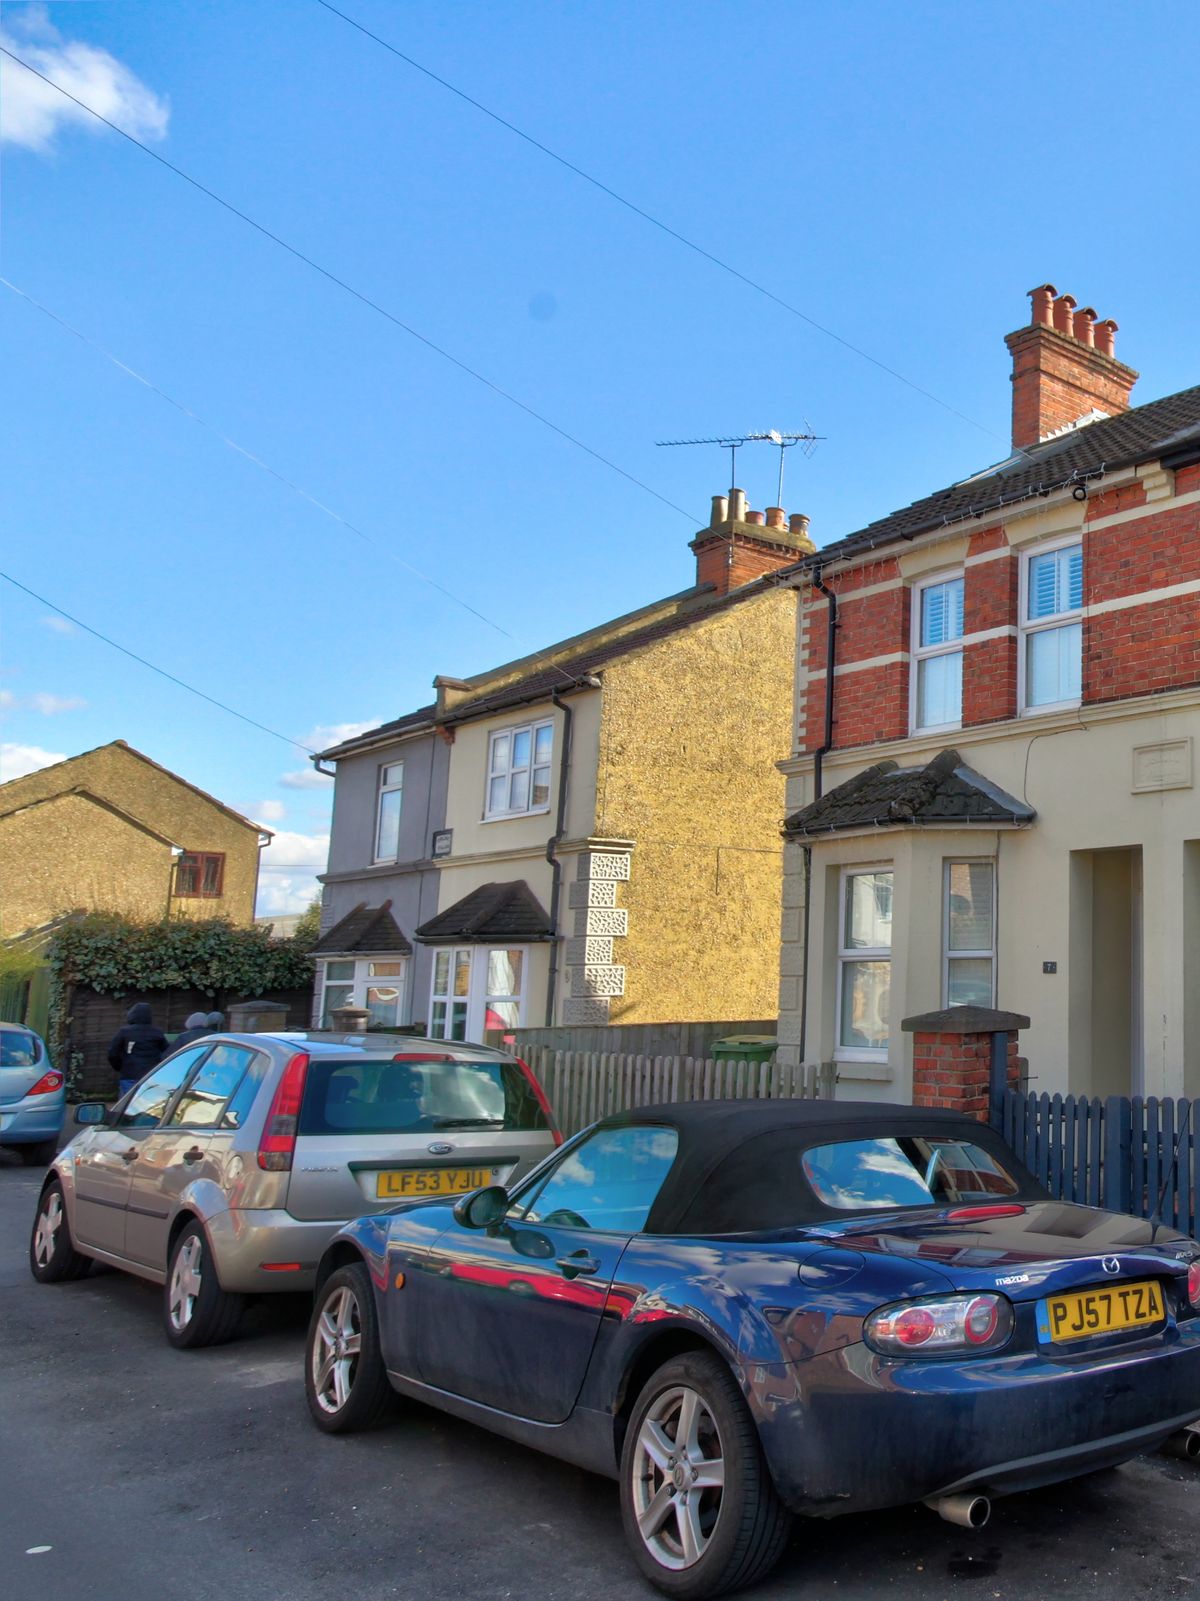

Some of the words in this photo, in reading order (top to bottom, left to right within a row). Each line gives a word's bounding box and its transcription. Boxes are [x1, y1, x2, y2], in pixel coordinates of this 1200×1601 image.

[386, 1173, 441, 1193] LF53
[446, 1171, 484, 1190] YJU
[1052, 1294, 1112, 1335] PJ57
[1118, 1287, 1160, 1321] TZA
